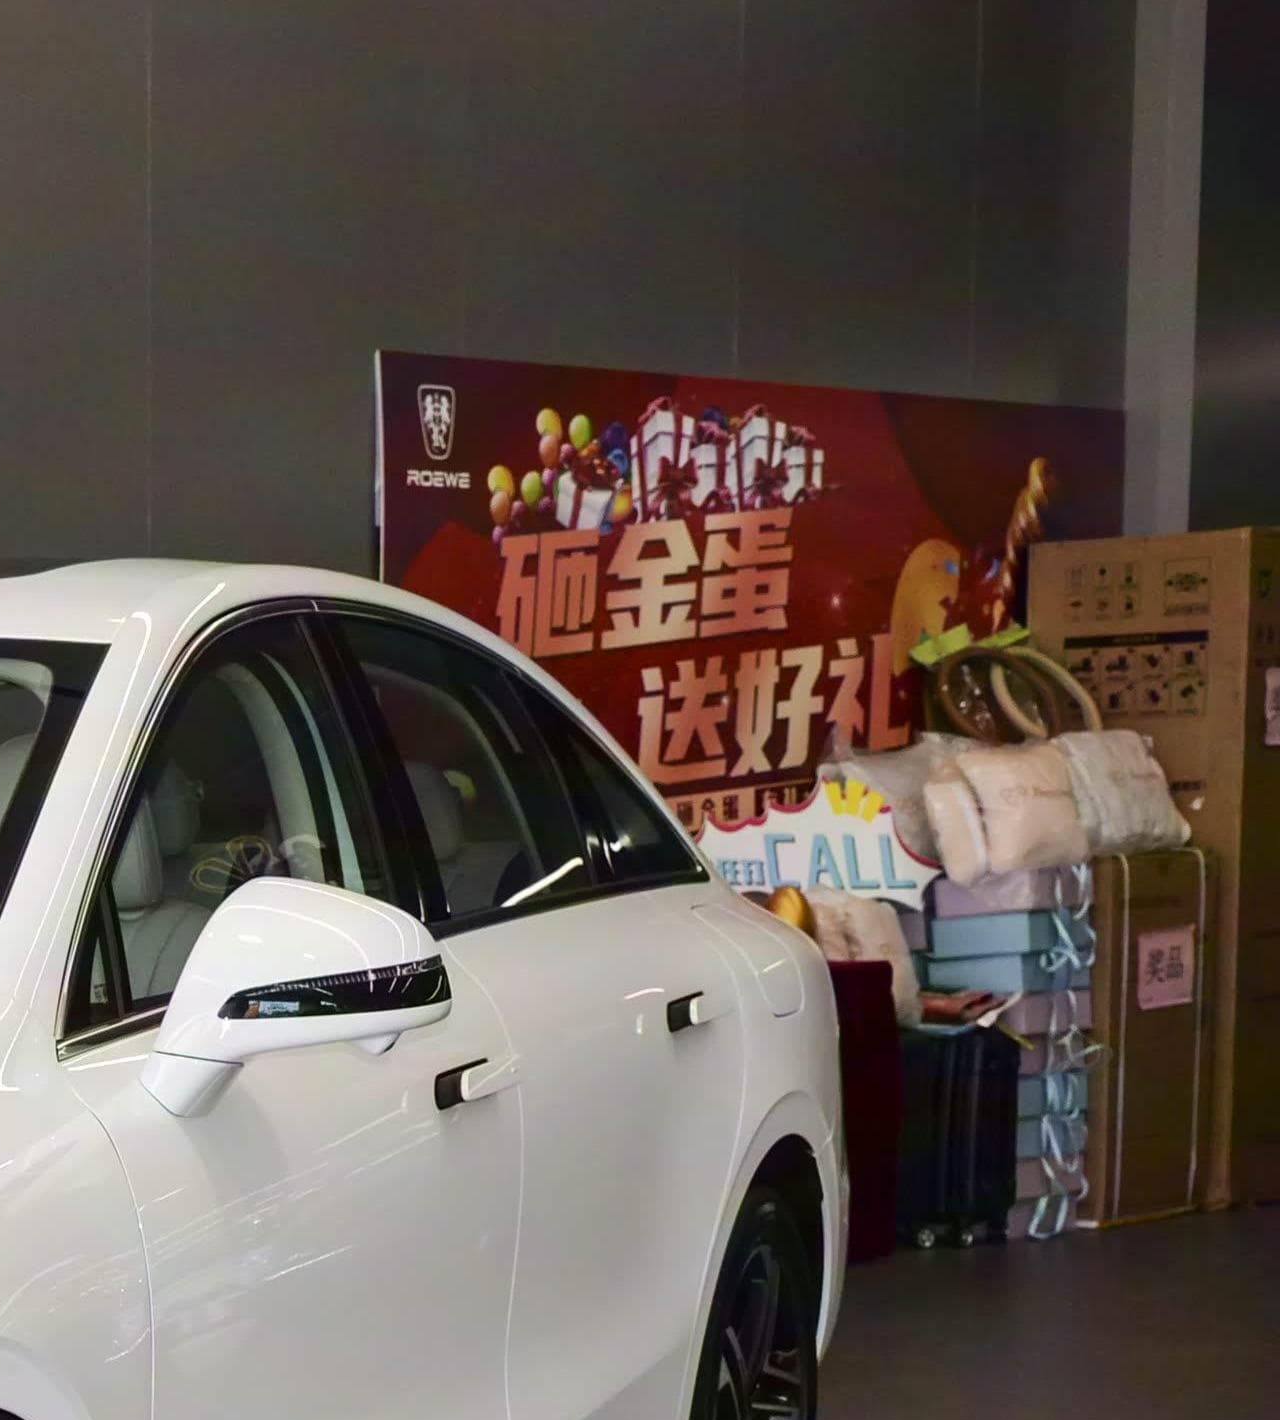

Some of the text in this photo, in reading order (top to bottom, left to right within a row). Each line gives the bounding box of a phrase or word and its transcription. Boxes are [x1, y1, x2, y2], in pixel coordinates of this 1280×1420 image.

[406, 469, 471, 489] ROEWE
[494, 507, 794, 658] 砸金蛋
[638, 633, 910, 784] 送好礼
